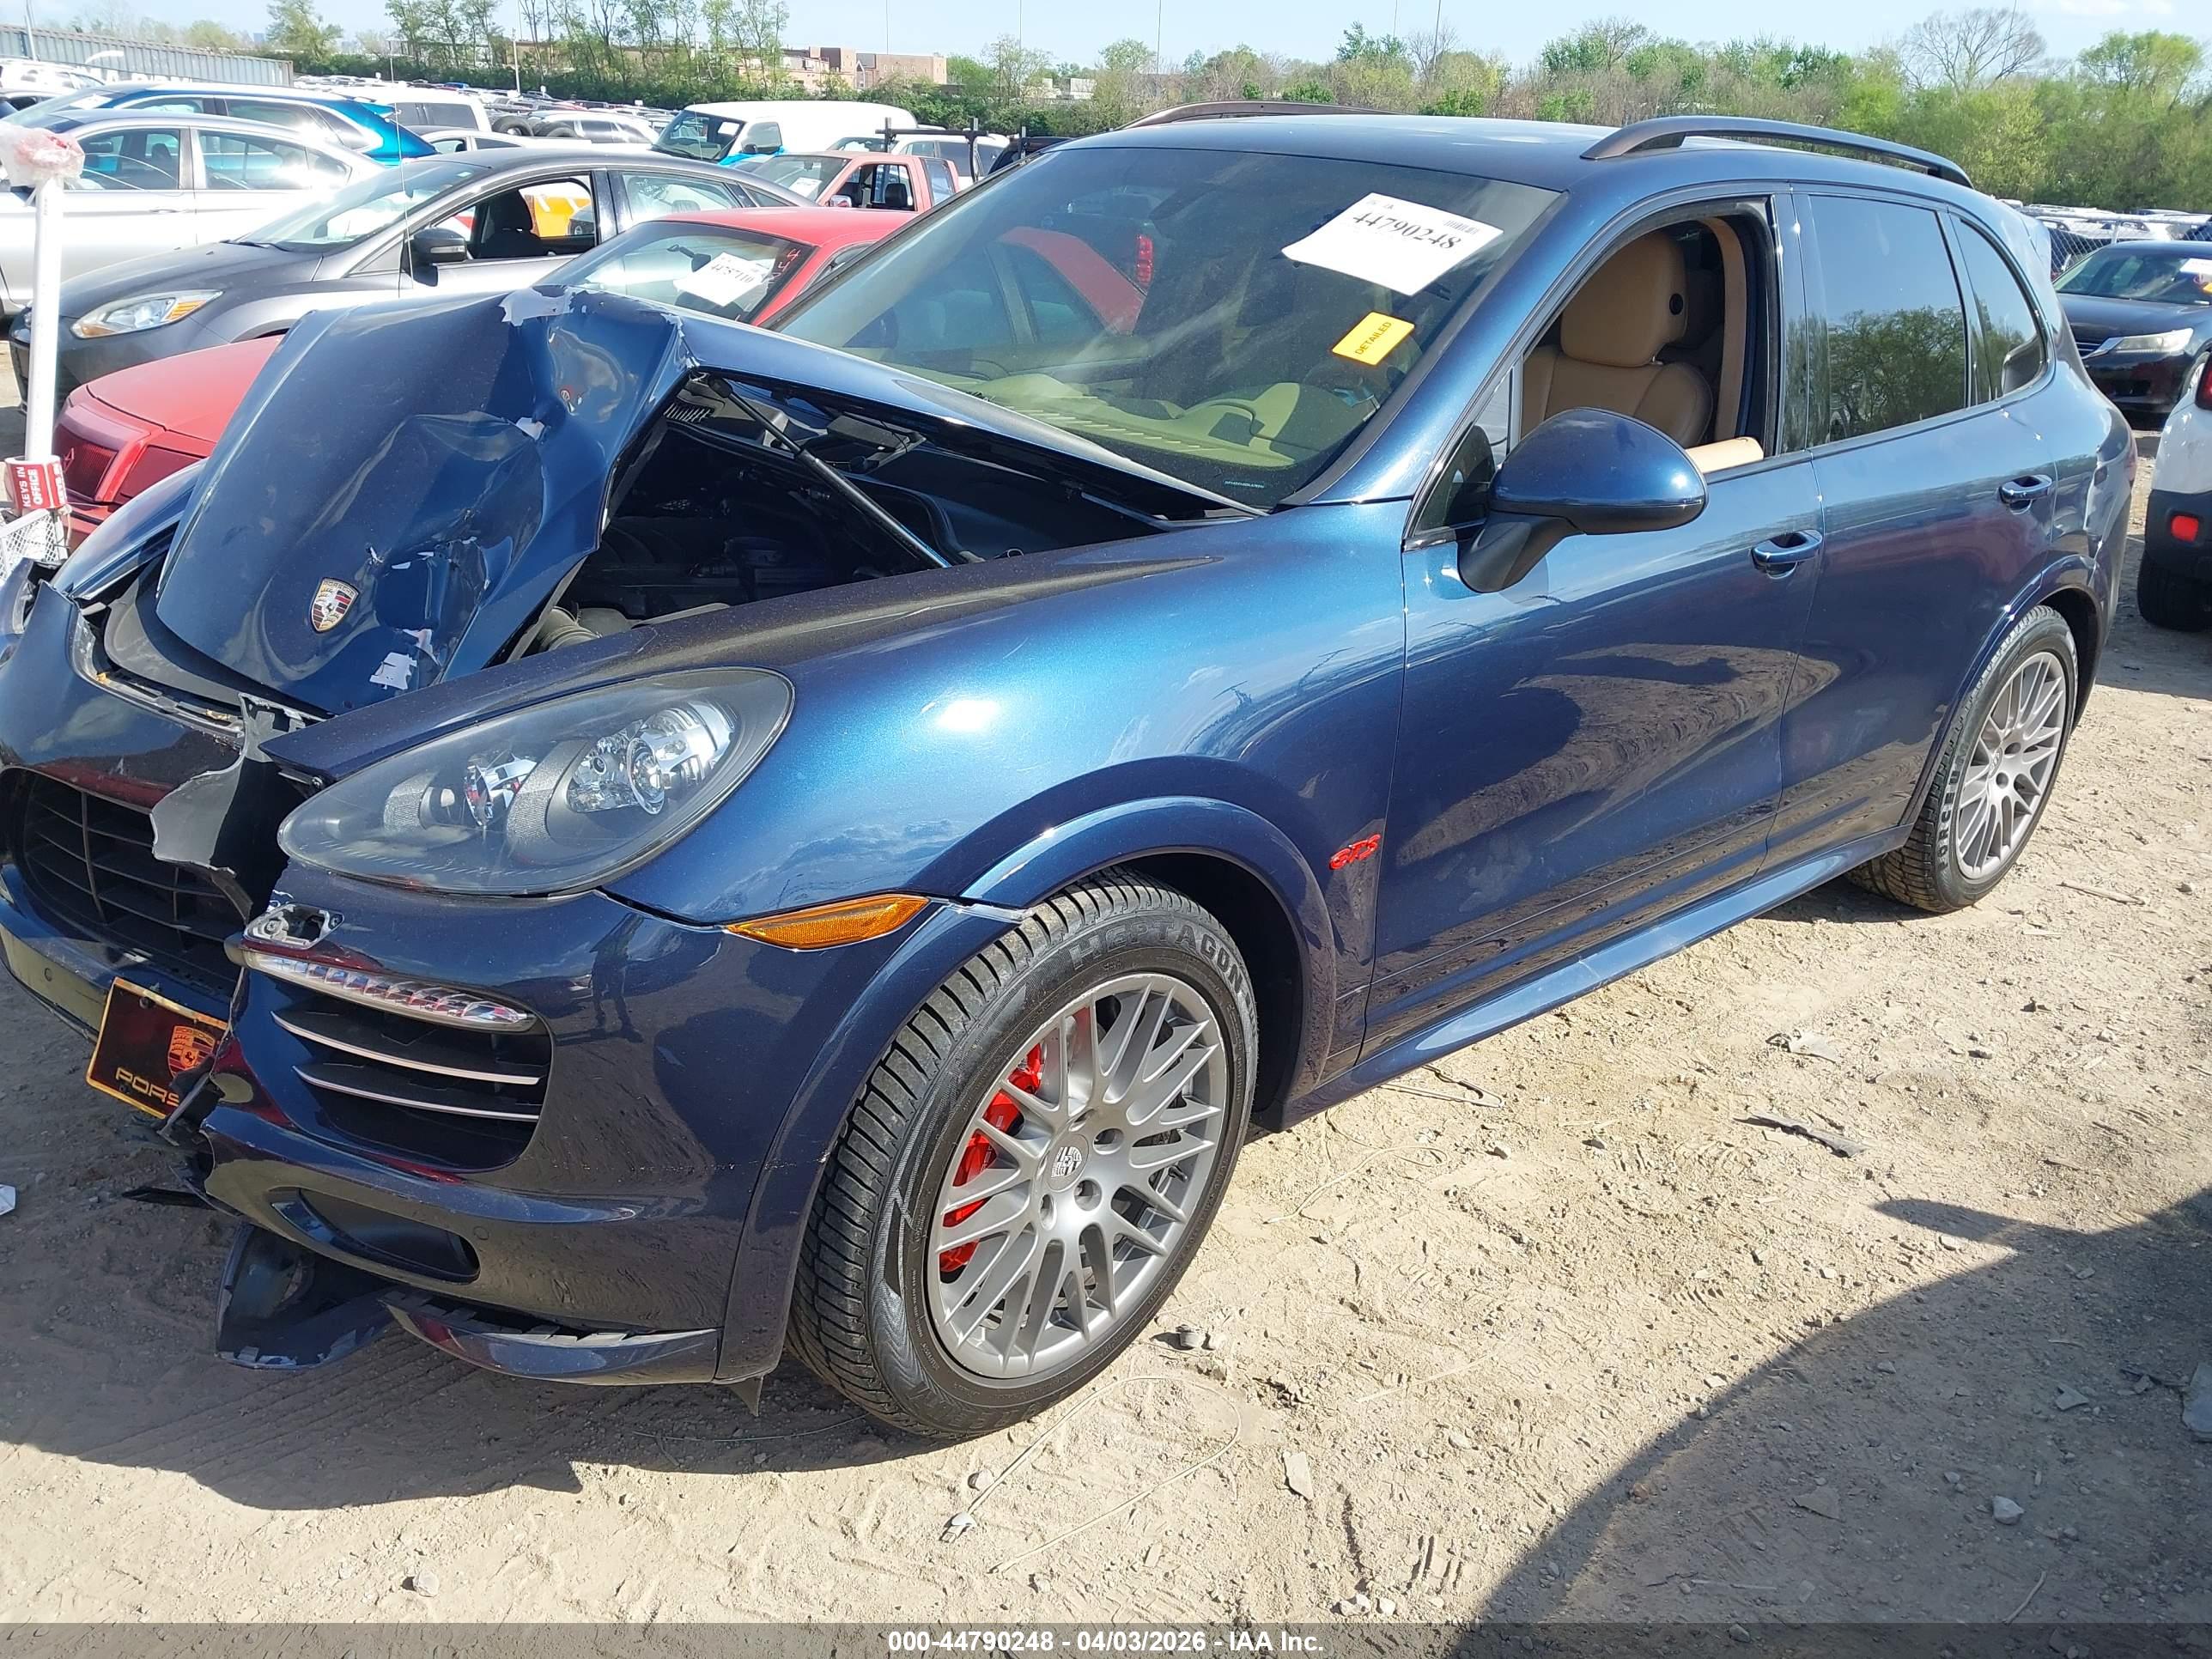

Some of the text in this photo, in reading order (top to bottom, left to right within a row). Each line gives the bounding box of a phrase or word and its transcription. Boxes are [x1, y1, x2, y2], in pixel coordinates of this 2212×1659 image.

[1352, 211, 1462, 249] 44790248
[1355, 321, 1392, 355] DETAILED
[16, 466, 32, 507] KEYS IN
[27, 469, 44, 506] OFFICE
[1328, 834, 1381, 870] GTS
